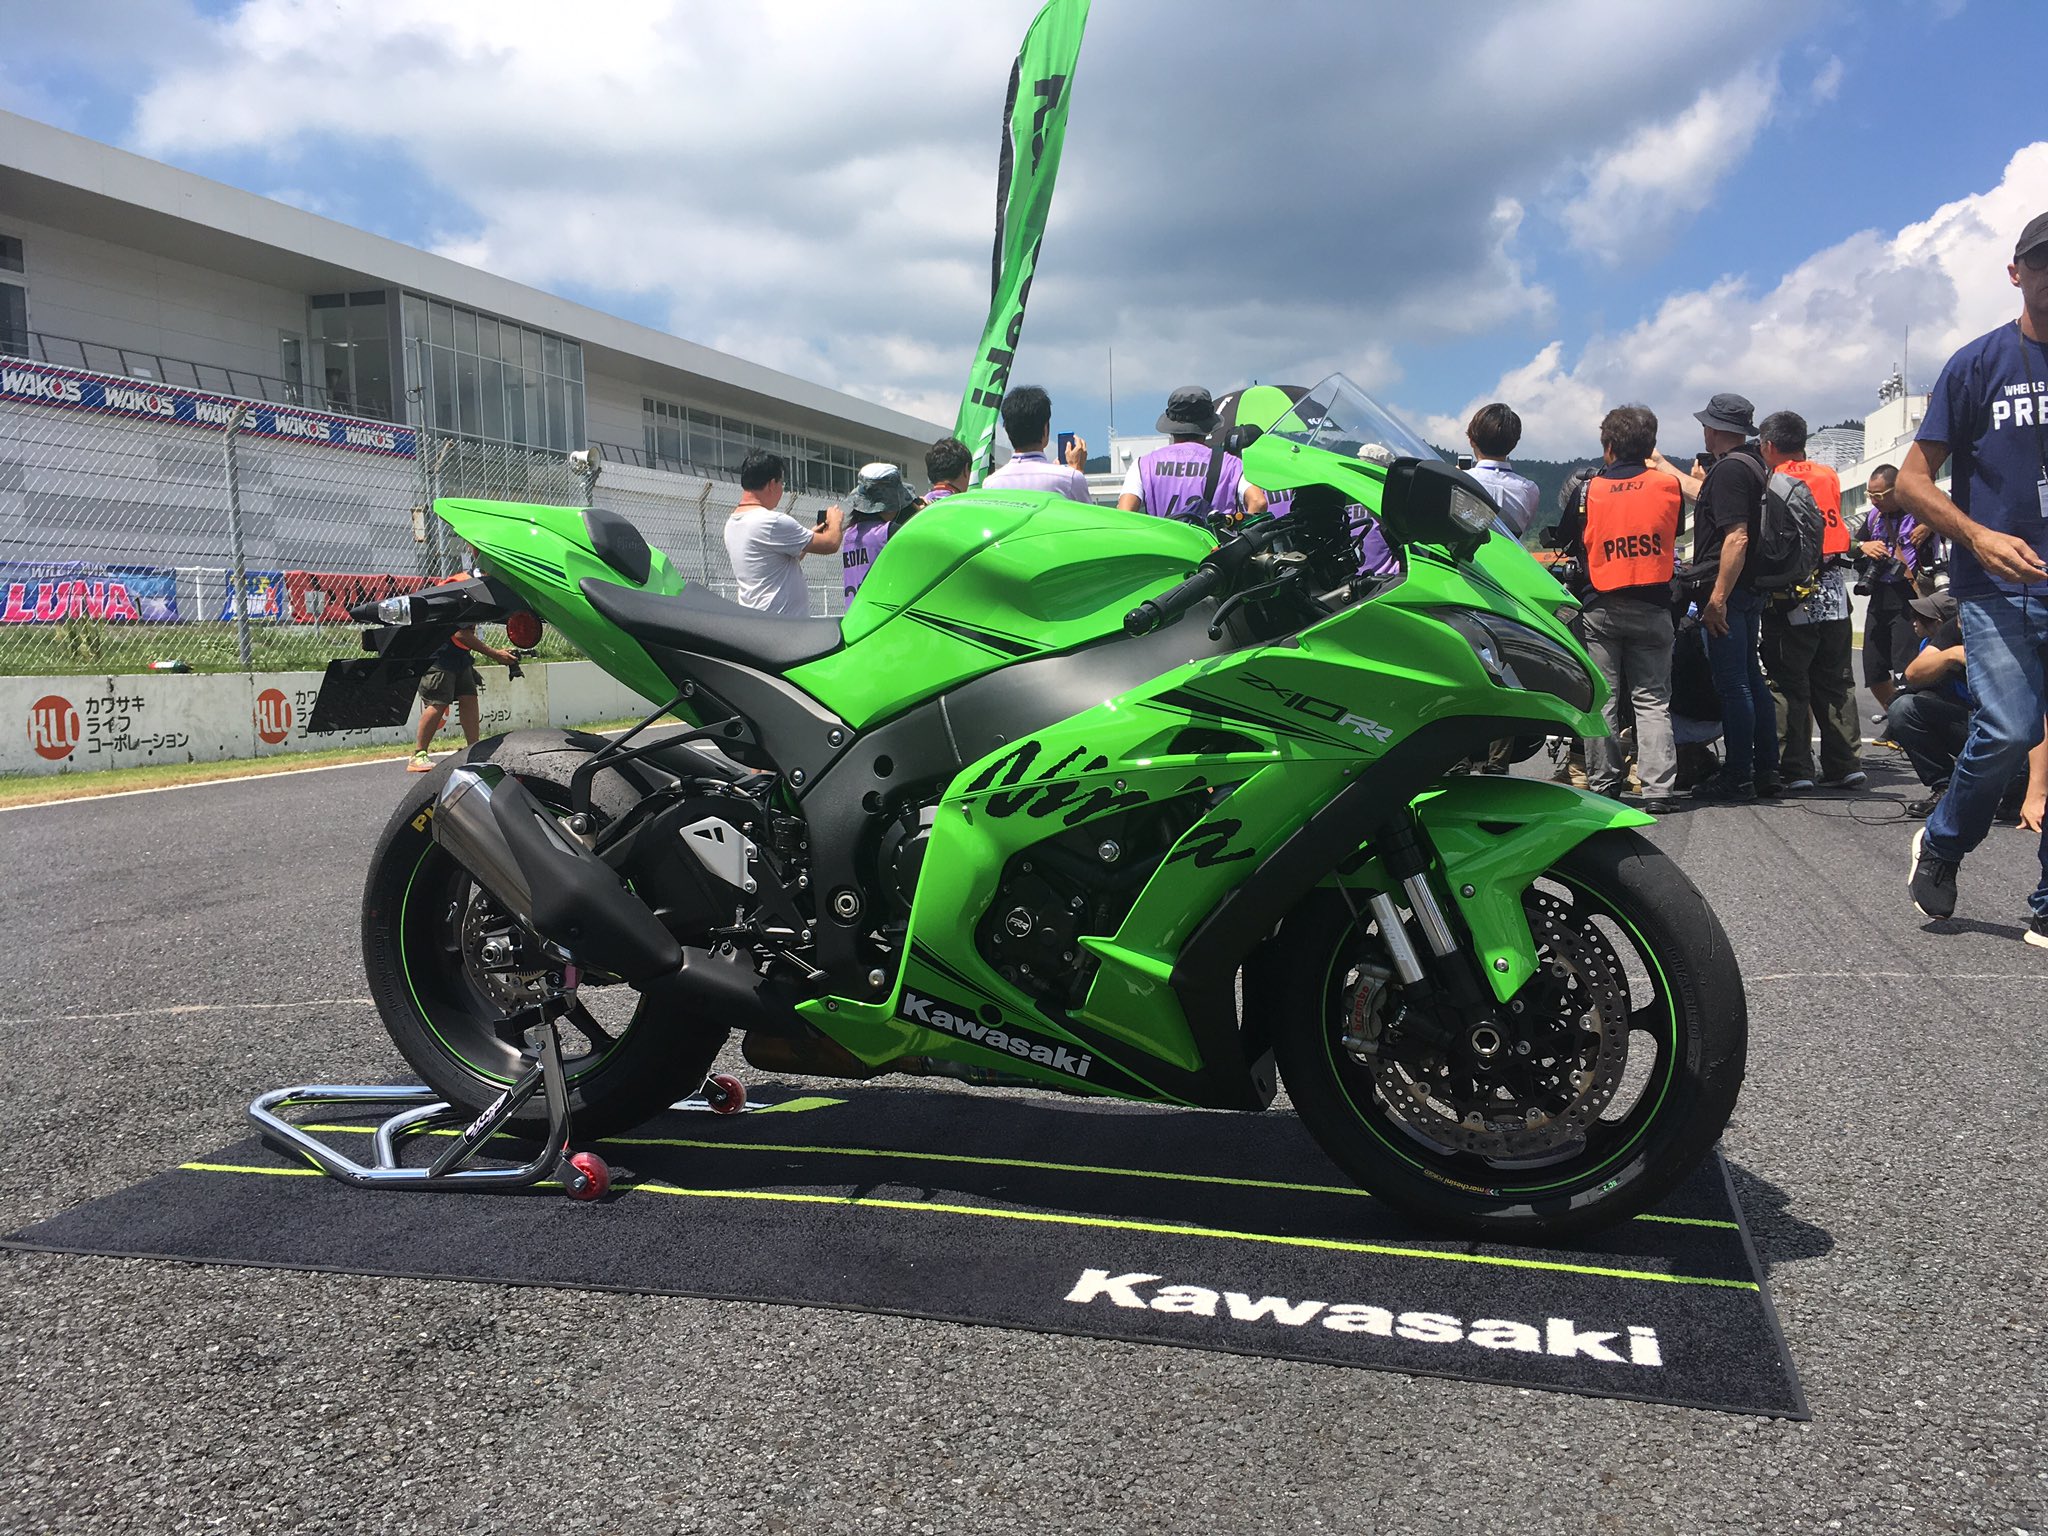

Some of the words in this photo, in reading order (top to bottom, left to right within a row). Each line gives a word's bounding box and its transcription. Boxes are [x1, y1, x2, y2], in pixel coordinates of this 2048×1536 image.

[1155, 461, 1209, 478] MEDI
[1610, 481, 1644, 494] MFJ
[842, 547, 869, 569] EDIA
[1603, 533, 1662, 562] PRESS
[2, 580, 139, 623] LUNA
[86, 696, 145, 715] カワサキ
[87, 716, 130, 734] ライフ
[88, 732, 190, 754] コーポレーション
[1353, 985, 1370, 1032] brembo
[903, 992, 1092, 1077] Kawasaki
[1064, 1269, 1663, 1366] Kawasaki
